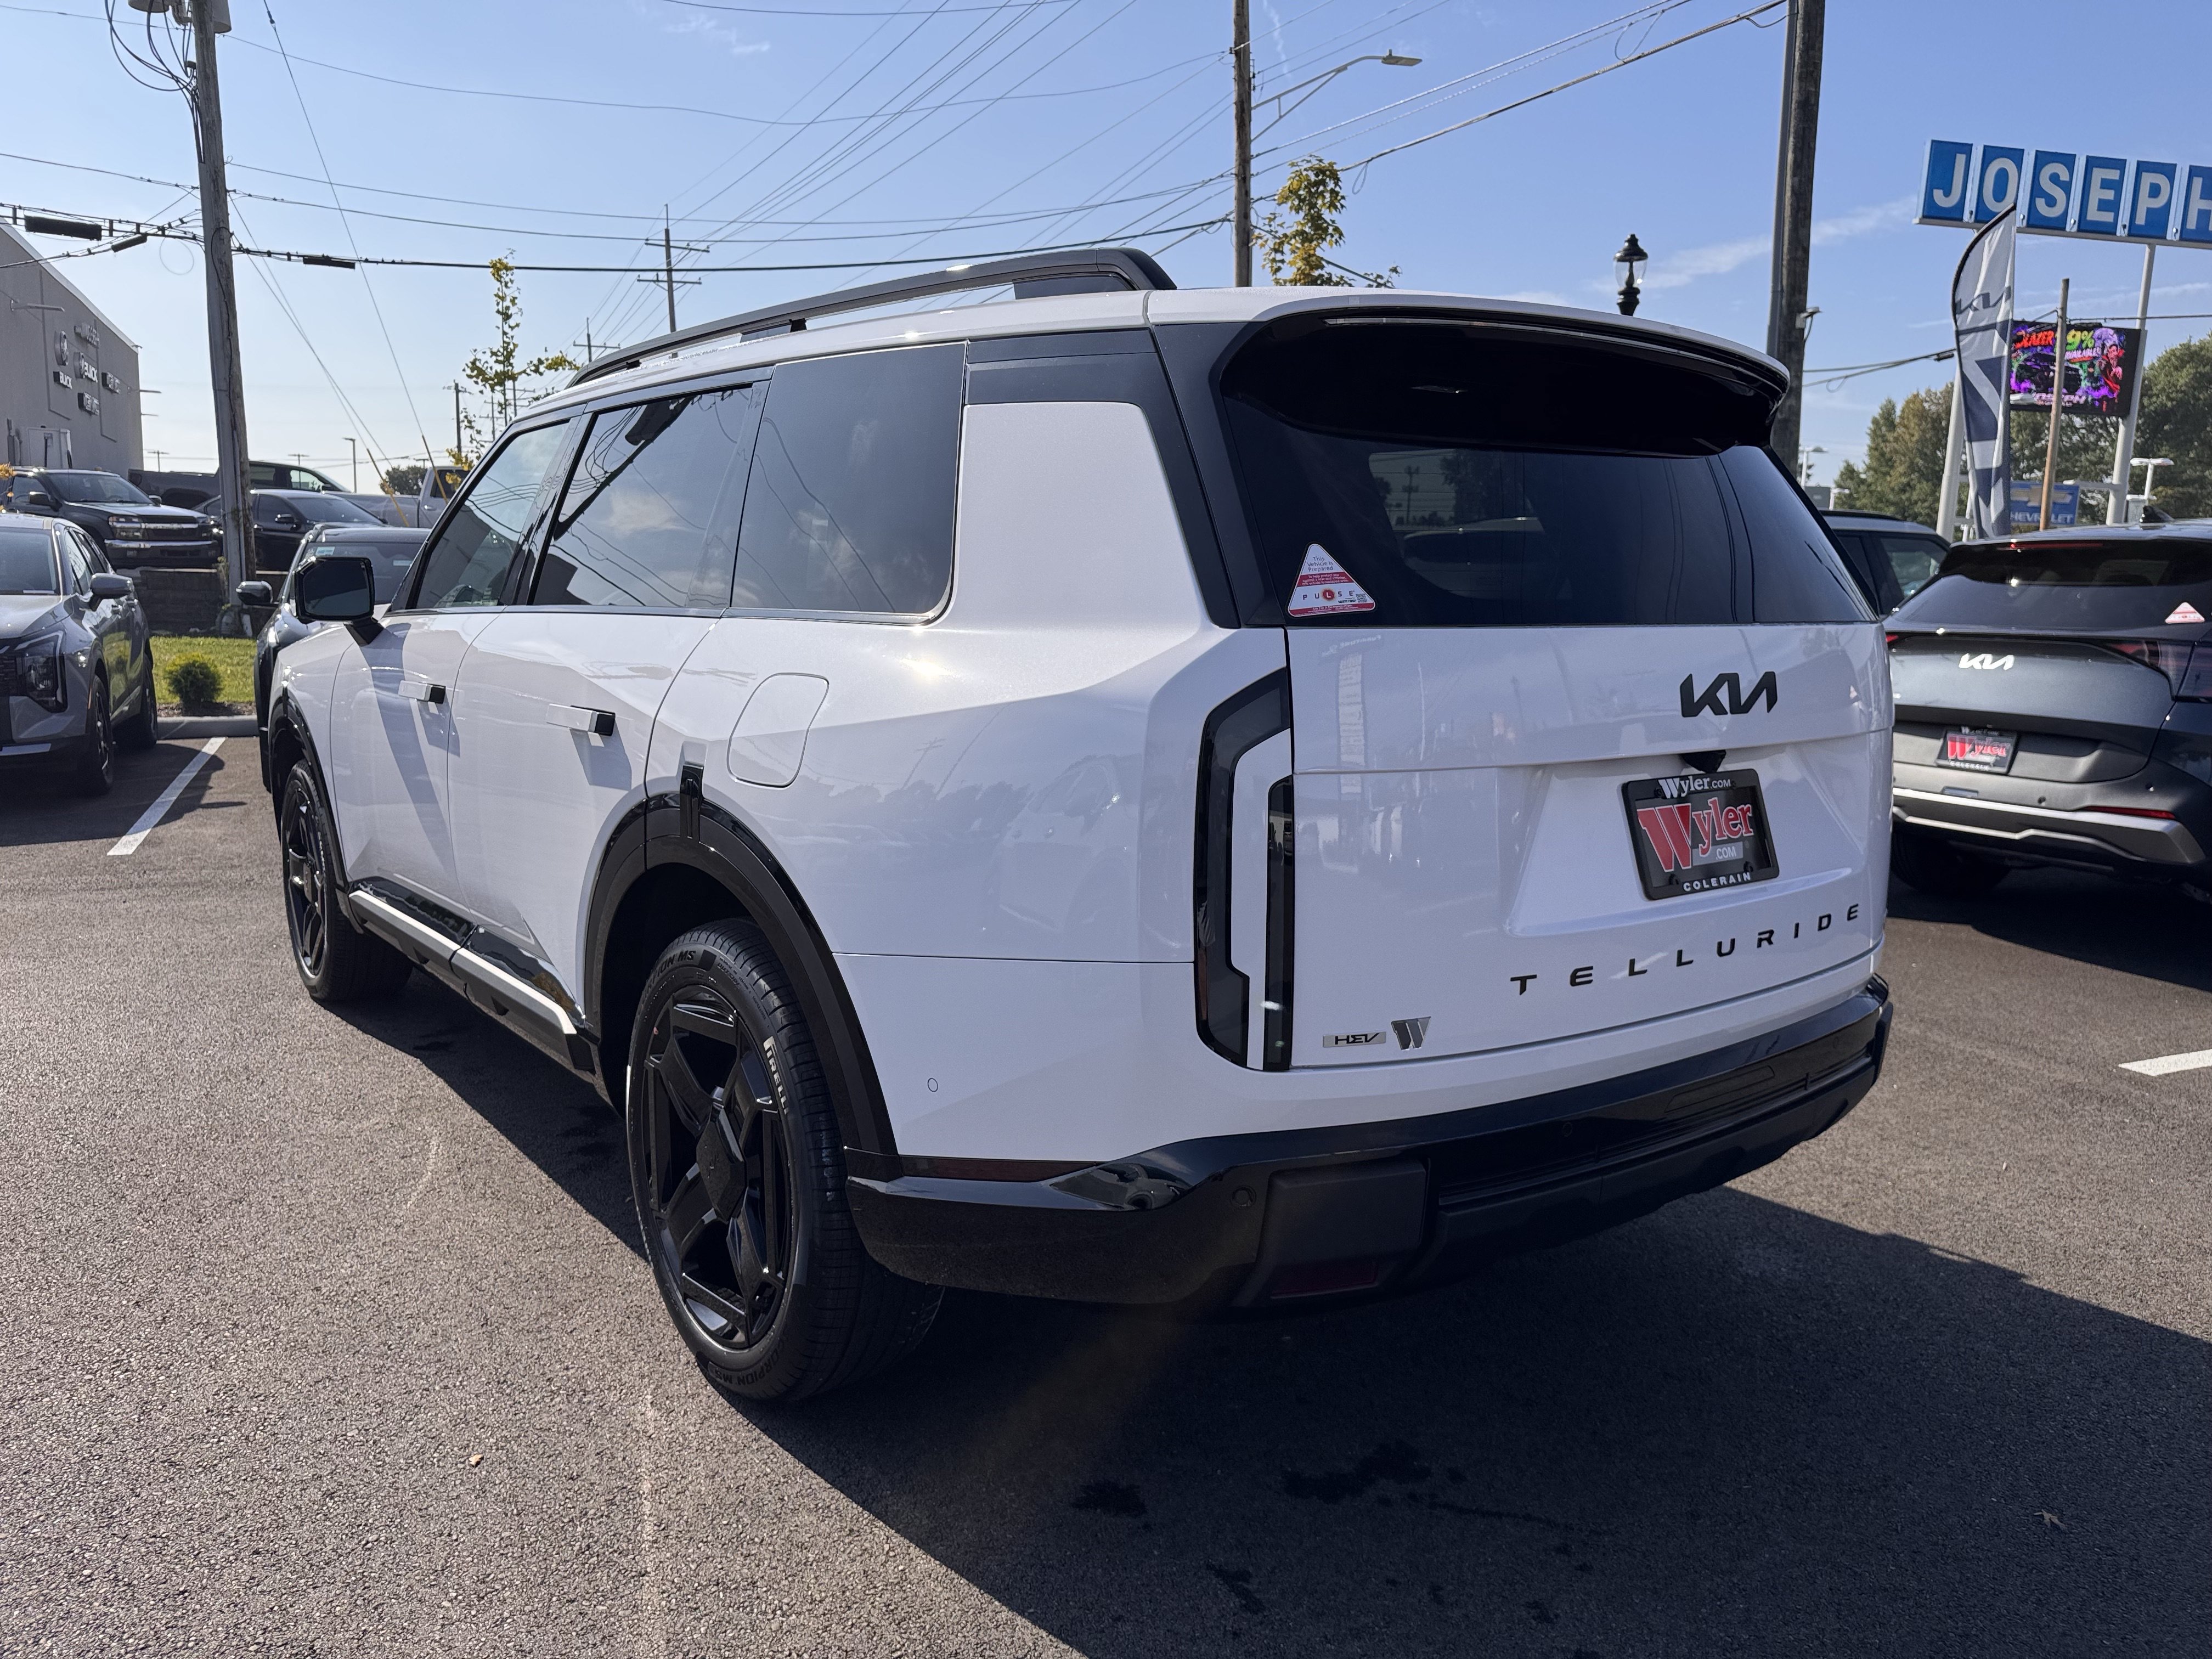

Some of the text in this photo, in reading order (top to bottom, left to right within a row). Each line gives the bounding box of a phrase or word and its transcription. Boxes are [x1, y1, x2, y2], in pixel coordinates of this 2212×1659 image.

[1932, 153, 2212, 230] JOSEPH
[1302, 590, 1354, 600] PULSE
[1959, 652, 2015, 670] KIA
[1679, 671, 1778, 718] KIA
[1948, 734, 2011, 760] Wyler
[1637, 797, 1754, 873] Wyler
[1683, 872, 1751, 892] COLERAIN
[1510, 903, 1859, 996] TELLURIDE
[1334, 1032, 1380, 1045] HEV
[763, 1035, 789, 1115] PIRELLI
